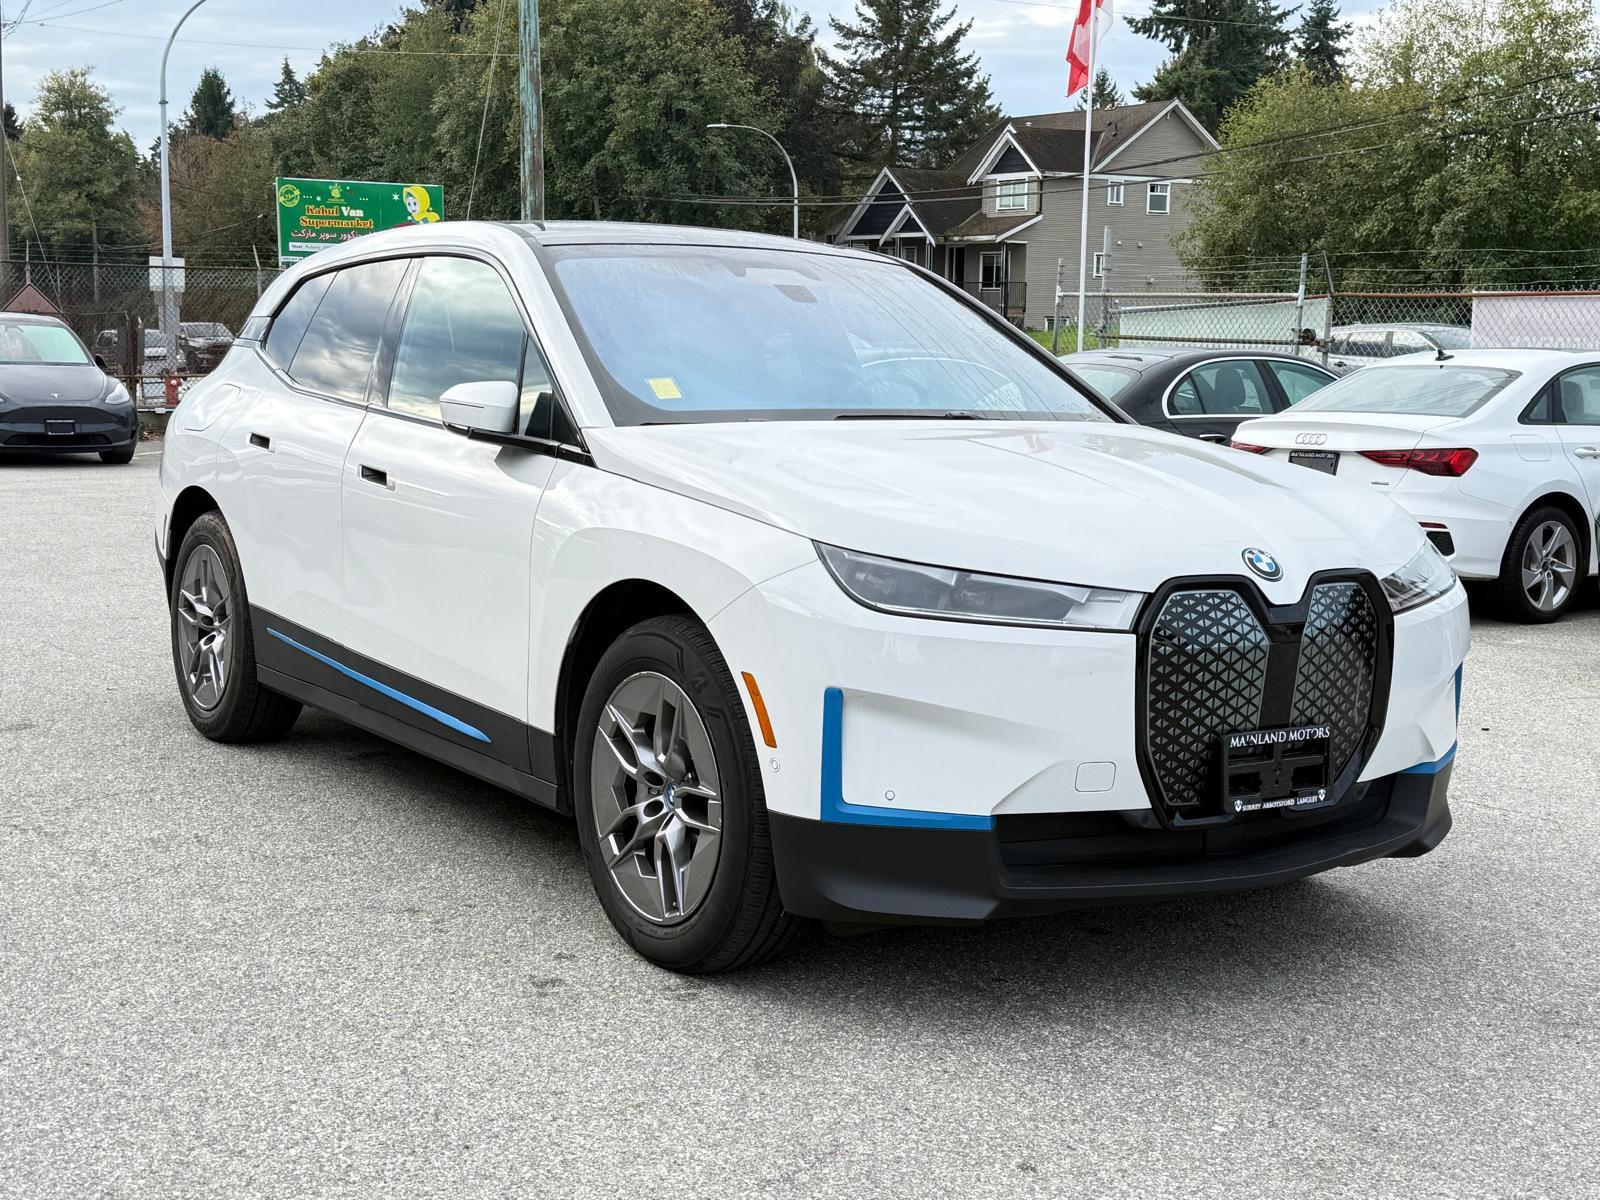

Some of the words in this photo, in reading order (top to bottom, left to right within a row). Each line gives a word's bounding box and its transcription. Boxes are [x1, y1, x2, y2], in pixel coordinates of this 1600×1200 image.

[341, 206, 364, 217] Van
[300, 216, 374, 229] Supermarket
[1288, 726, 1330, 742] MOTORS
[1242, 803, 1261, 811] SURREY
[1262, 799, 1295, 809] ABBOTSFORD
[1297, 795, 1318, 805] LANGLEY
